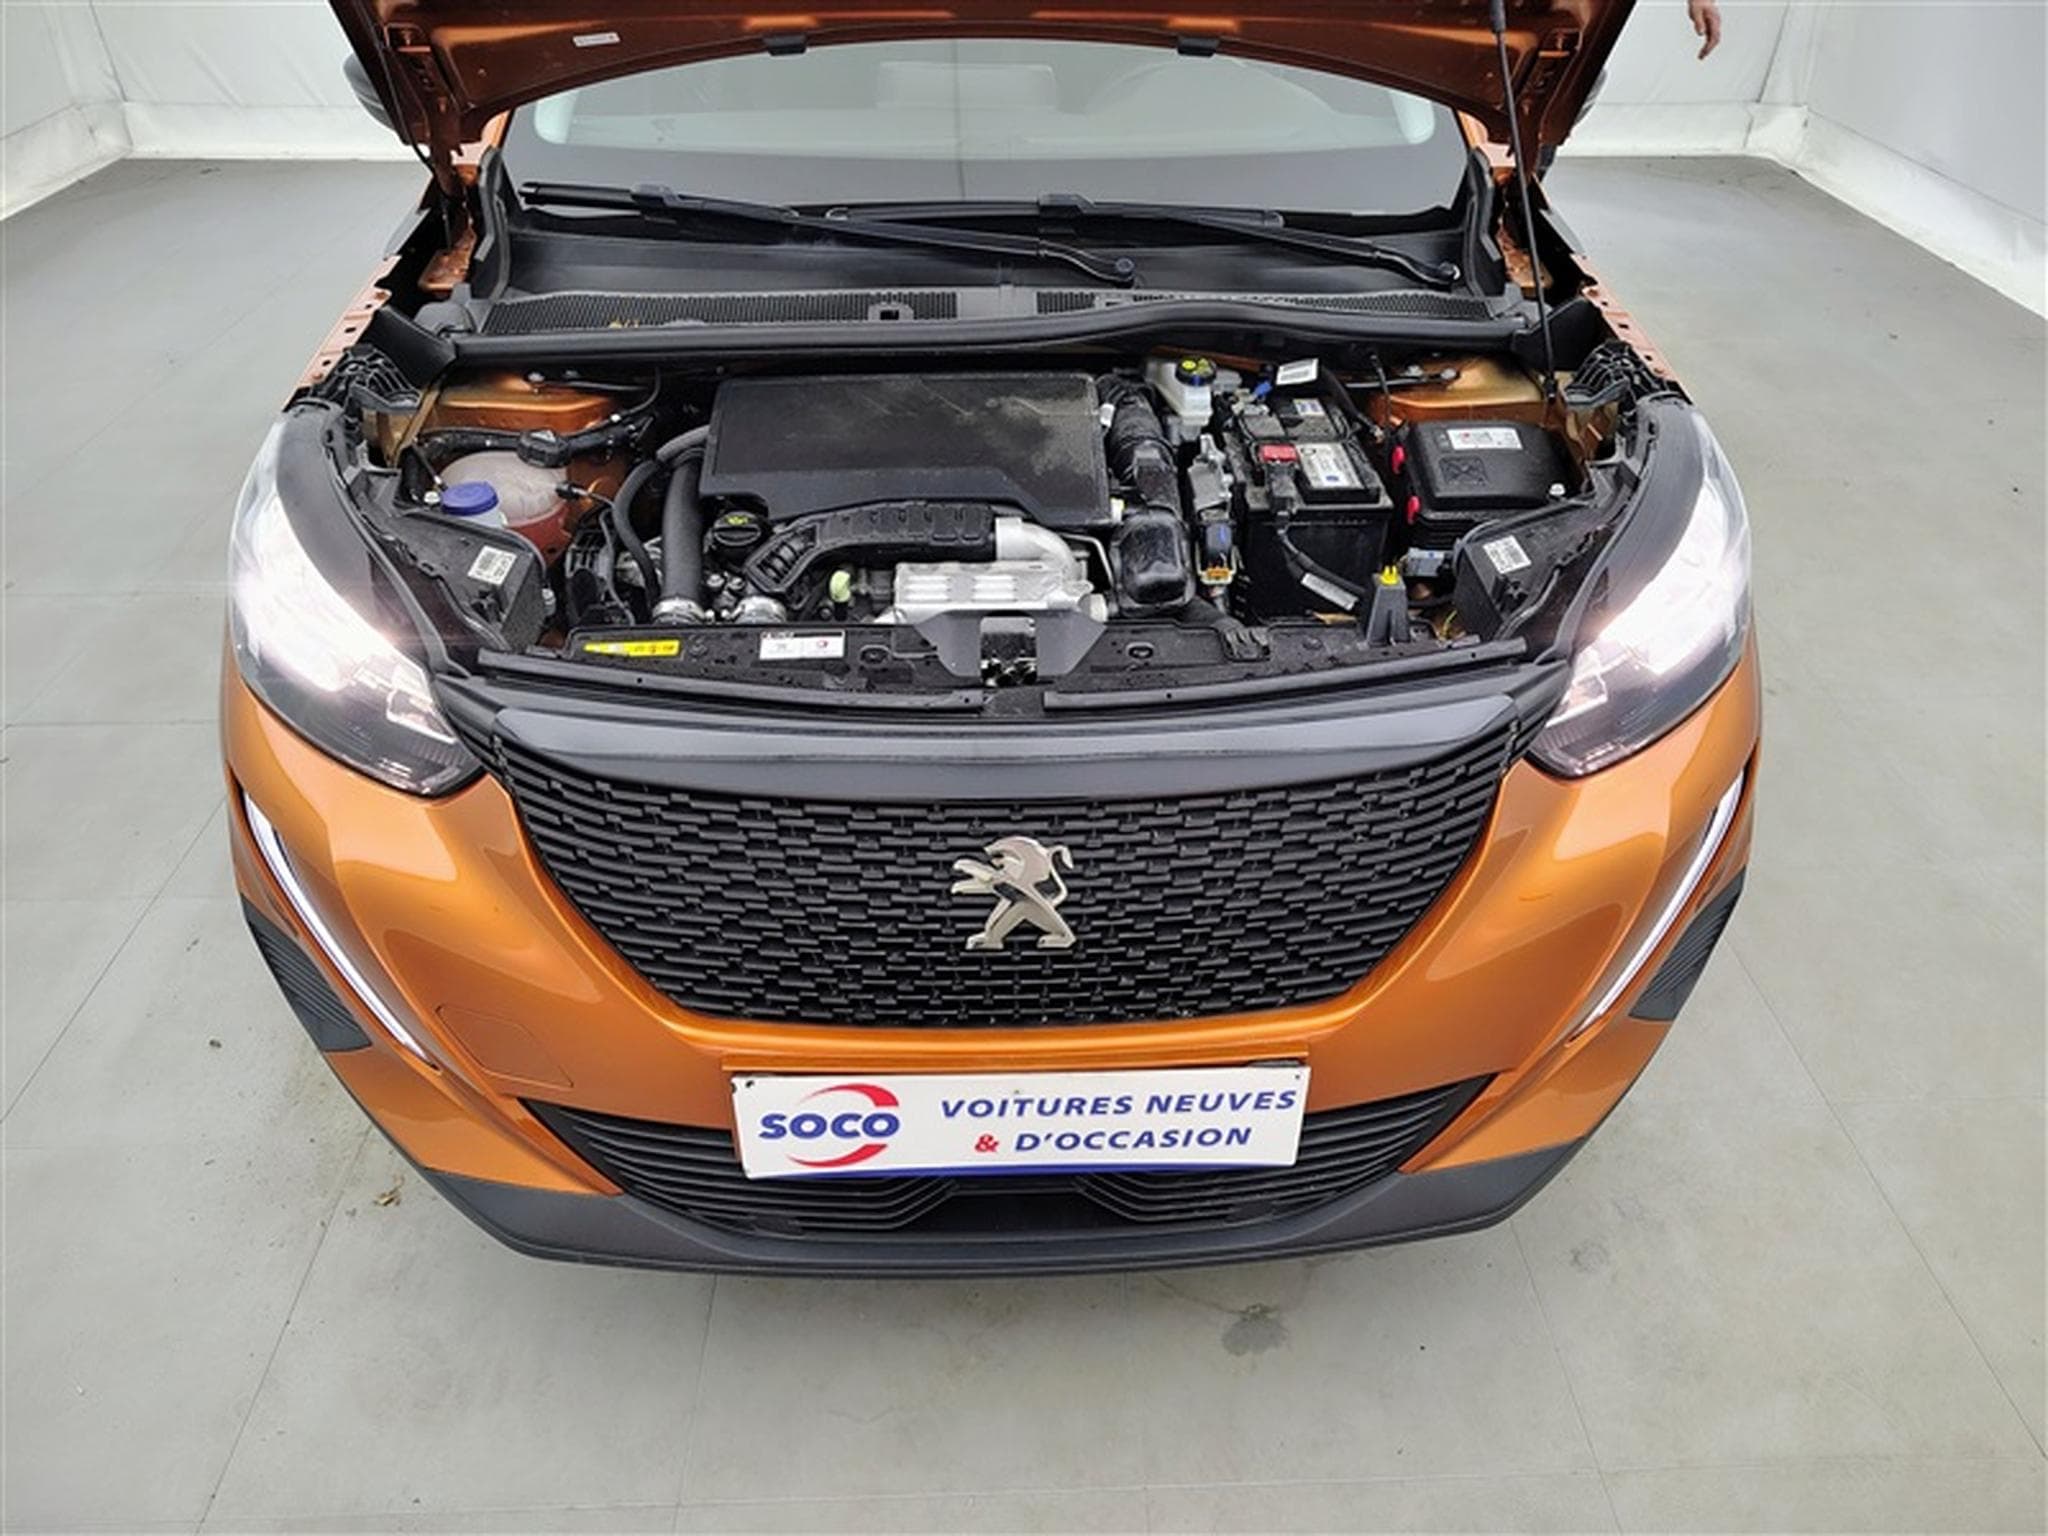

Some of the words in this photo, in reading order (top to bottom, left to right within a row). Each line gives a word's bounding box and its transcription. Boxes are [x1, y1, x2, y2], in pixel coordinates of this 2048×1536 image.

[941, 1096, 1133, 1118] VOITURES
[1146, 1090, 1297, 1113] NEUVES
[758, 1112, 901, 1139] SOCO
[974, 1134, 999, 1153] &
[1014, 1127, 1252, 1152] D'OCCASION
